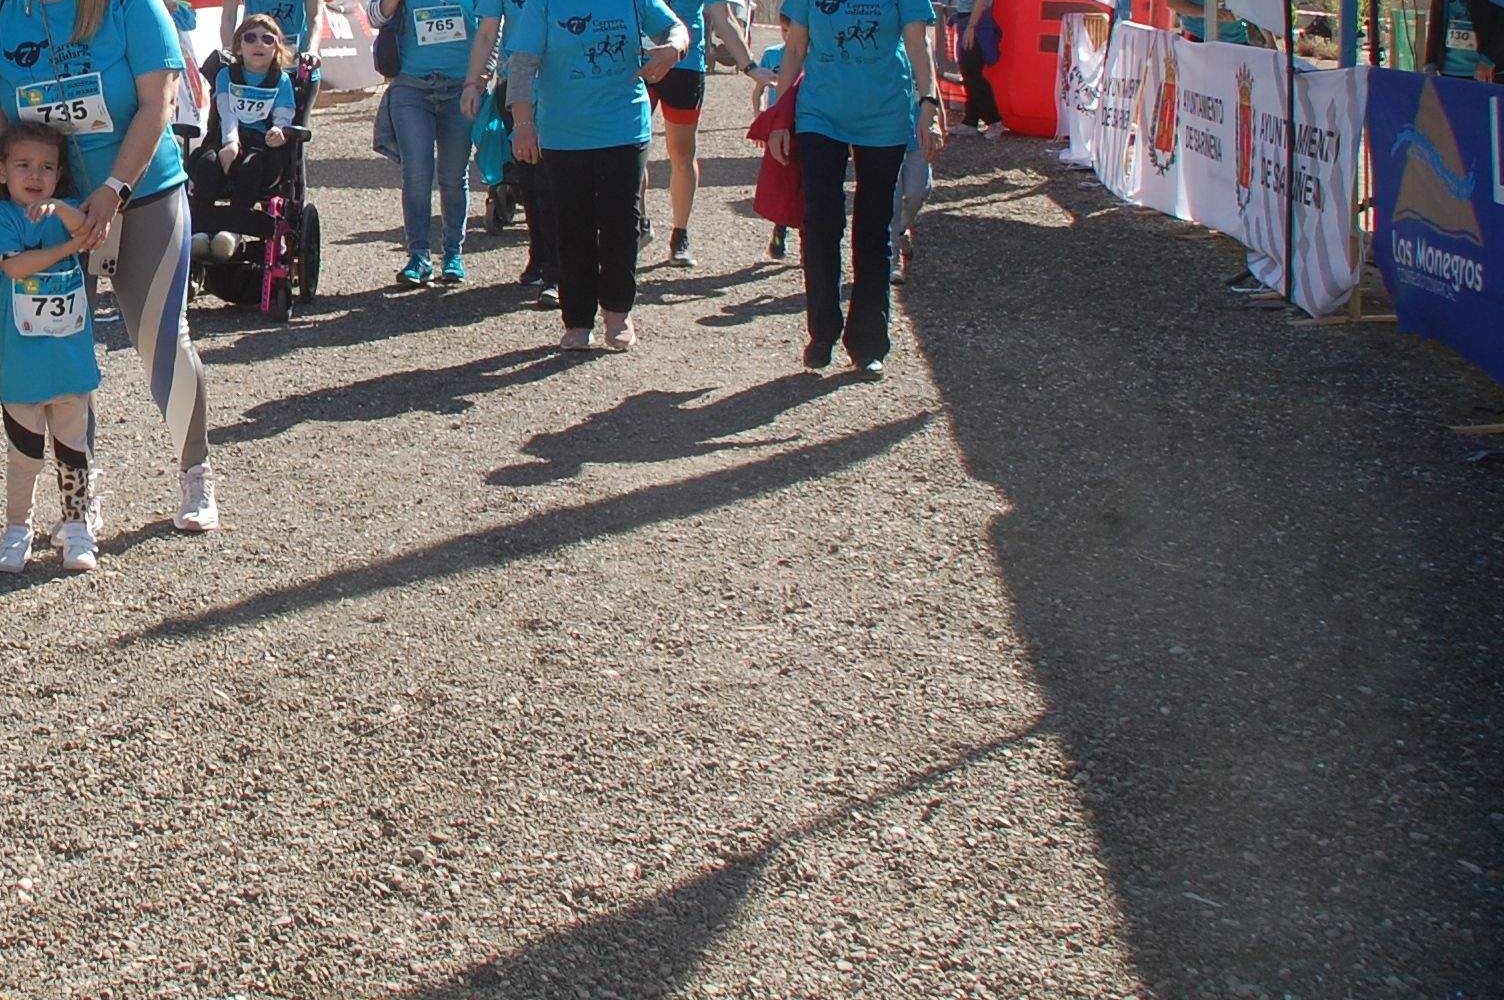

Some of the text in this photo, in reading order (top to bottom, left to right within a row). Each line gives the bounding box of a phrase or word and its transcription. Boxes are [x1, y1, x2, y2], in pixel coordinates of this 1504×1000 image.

[425, 19, 454, 32] 765
[1450, 32, 1470, 42] 130
[37, 100, 88, 123] 735
[236, 99, 265, 112] 379
[1392, 229, 1413, 267] Los
[1416, 236, 1484, 293] Monegros
[31, 293, 76, 317] 737
